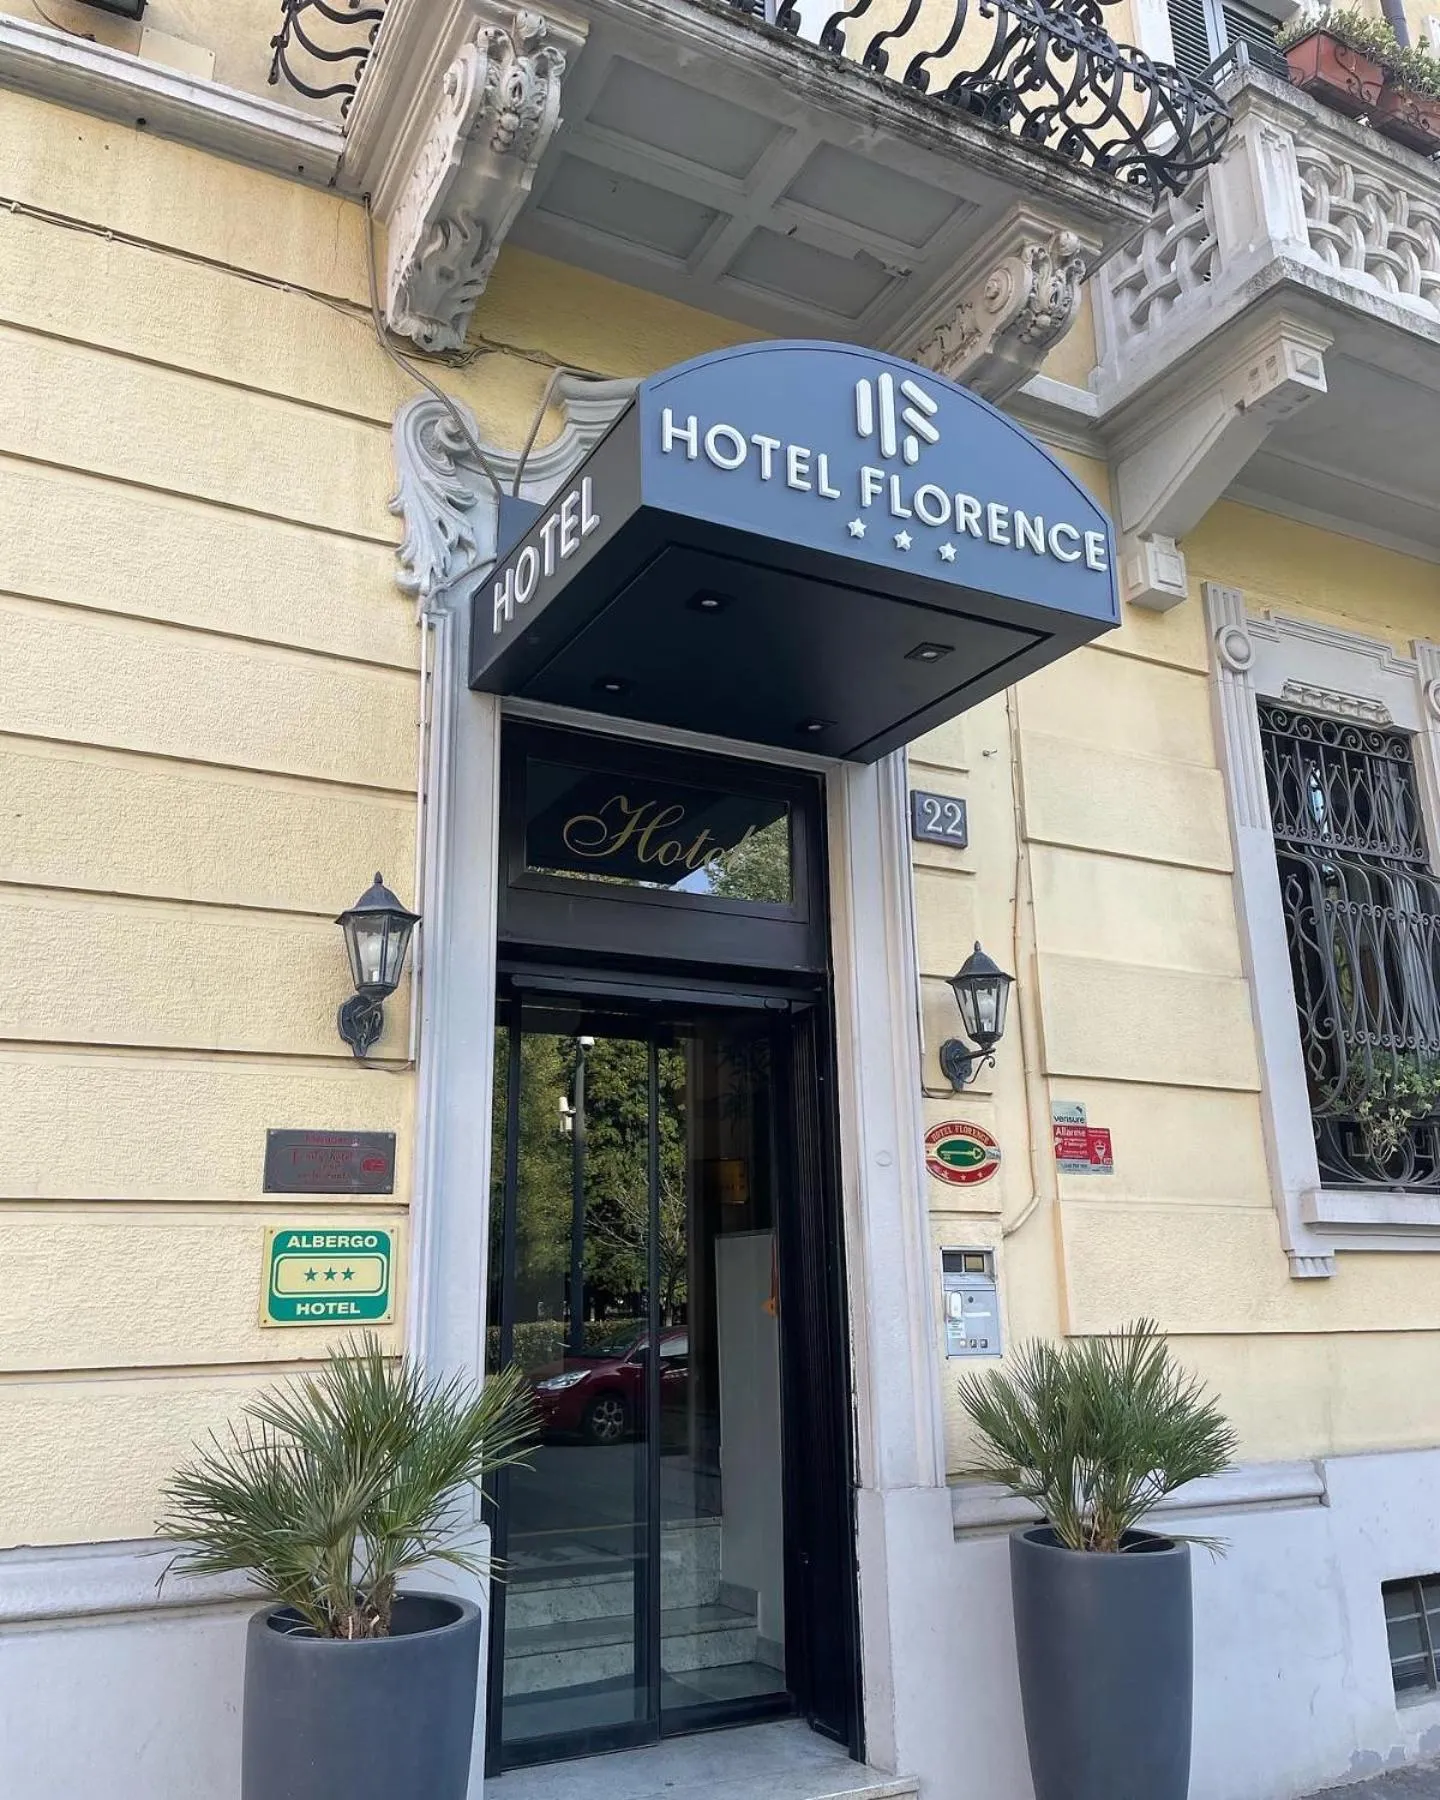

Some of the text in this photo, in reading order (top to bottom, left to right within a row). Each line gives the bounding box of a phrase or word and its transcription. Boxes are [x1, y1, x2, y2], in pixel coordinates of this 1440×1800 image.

[661, 407, 1109, 573] HOTEL FLORENCE
[492, 475, 601, 636] HOTEL
[562, 794, 757, 876] Hotel
[922, 798, 962, 837] 22
[286, 1235, 378, 1249] ALBERGO
[295, 1302, 361, 1315] HOTEL
